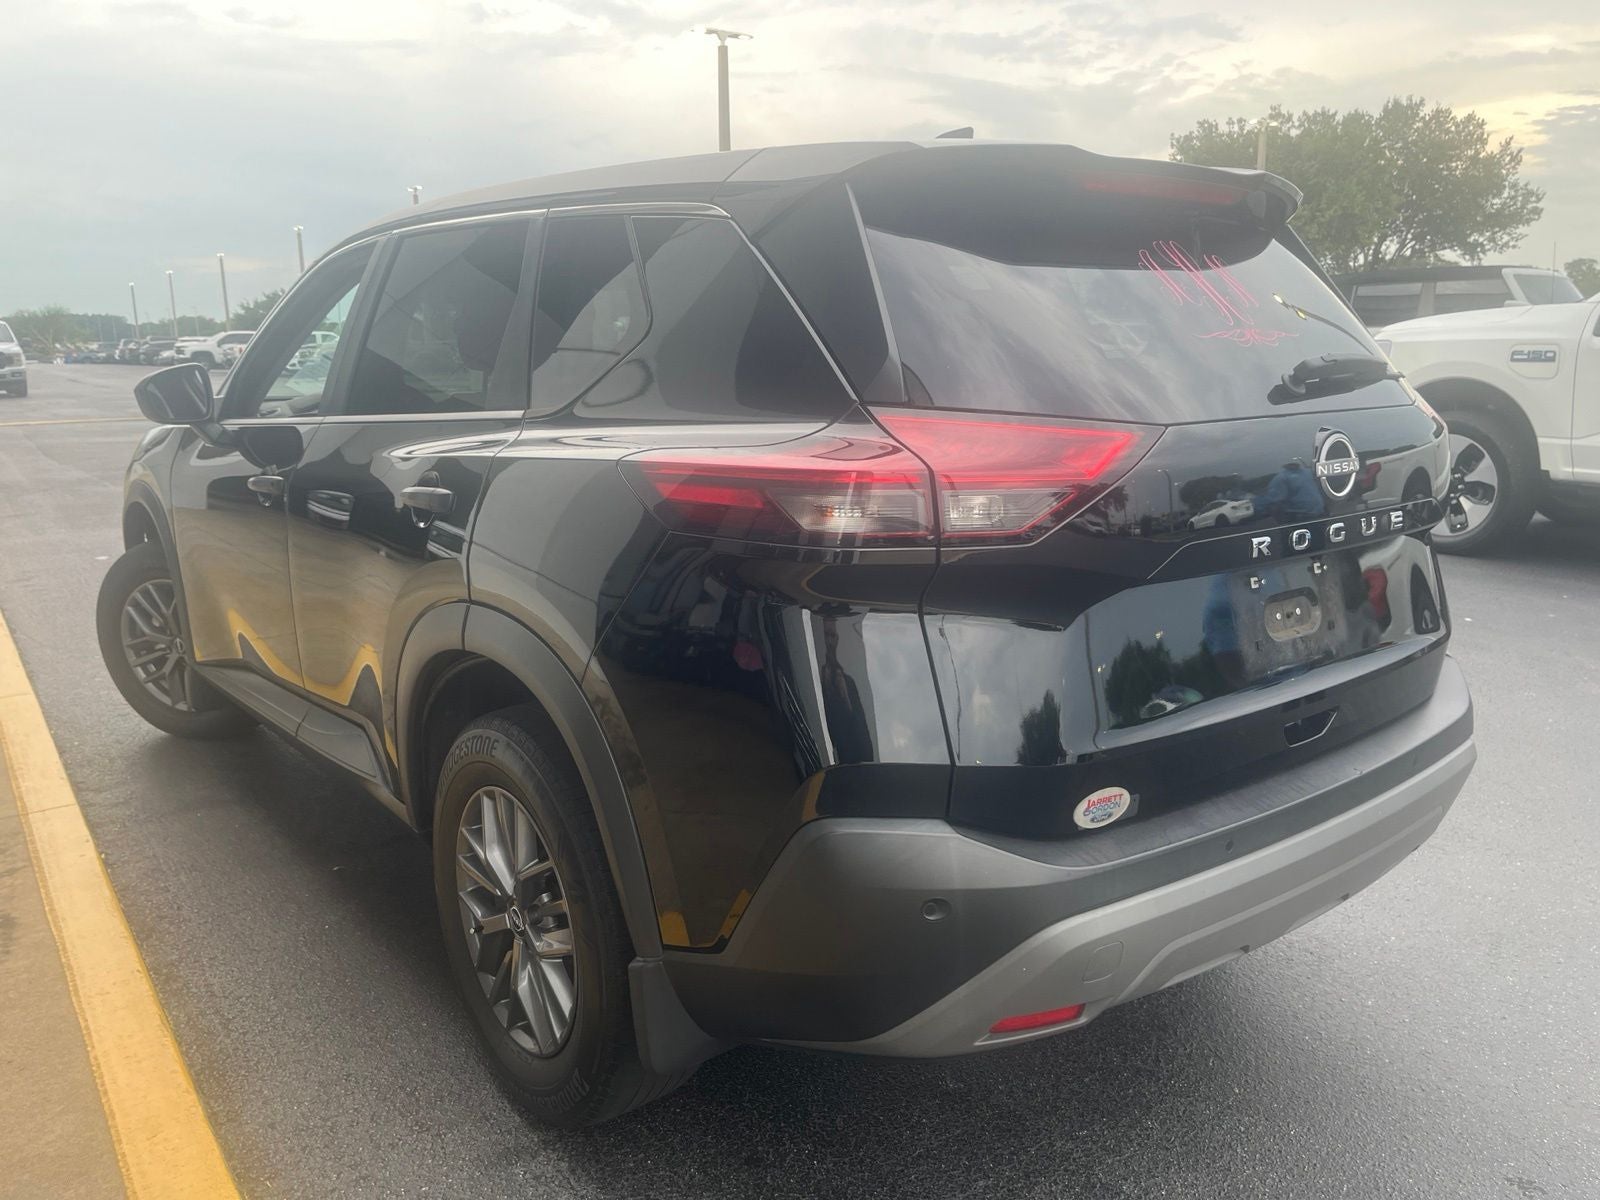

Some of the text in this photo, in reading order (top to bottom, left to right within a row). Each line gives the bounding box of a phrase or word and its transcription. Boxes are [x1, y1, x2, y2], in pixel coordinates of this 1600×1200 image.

[1316, 458, 1359, 475] NISSAN
[1251, 511, 1404, 558] ROGUE
[1086, 793, 1124, 811] JARRETT
